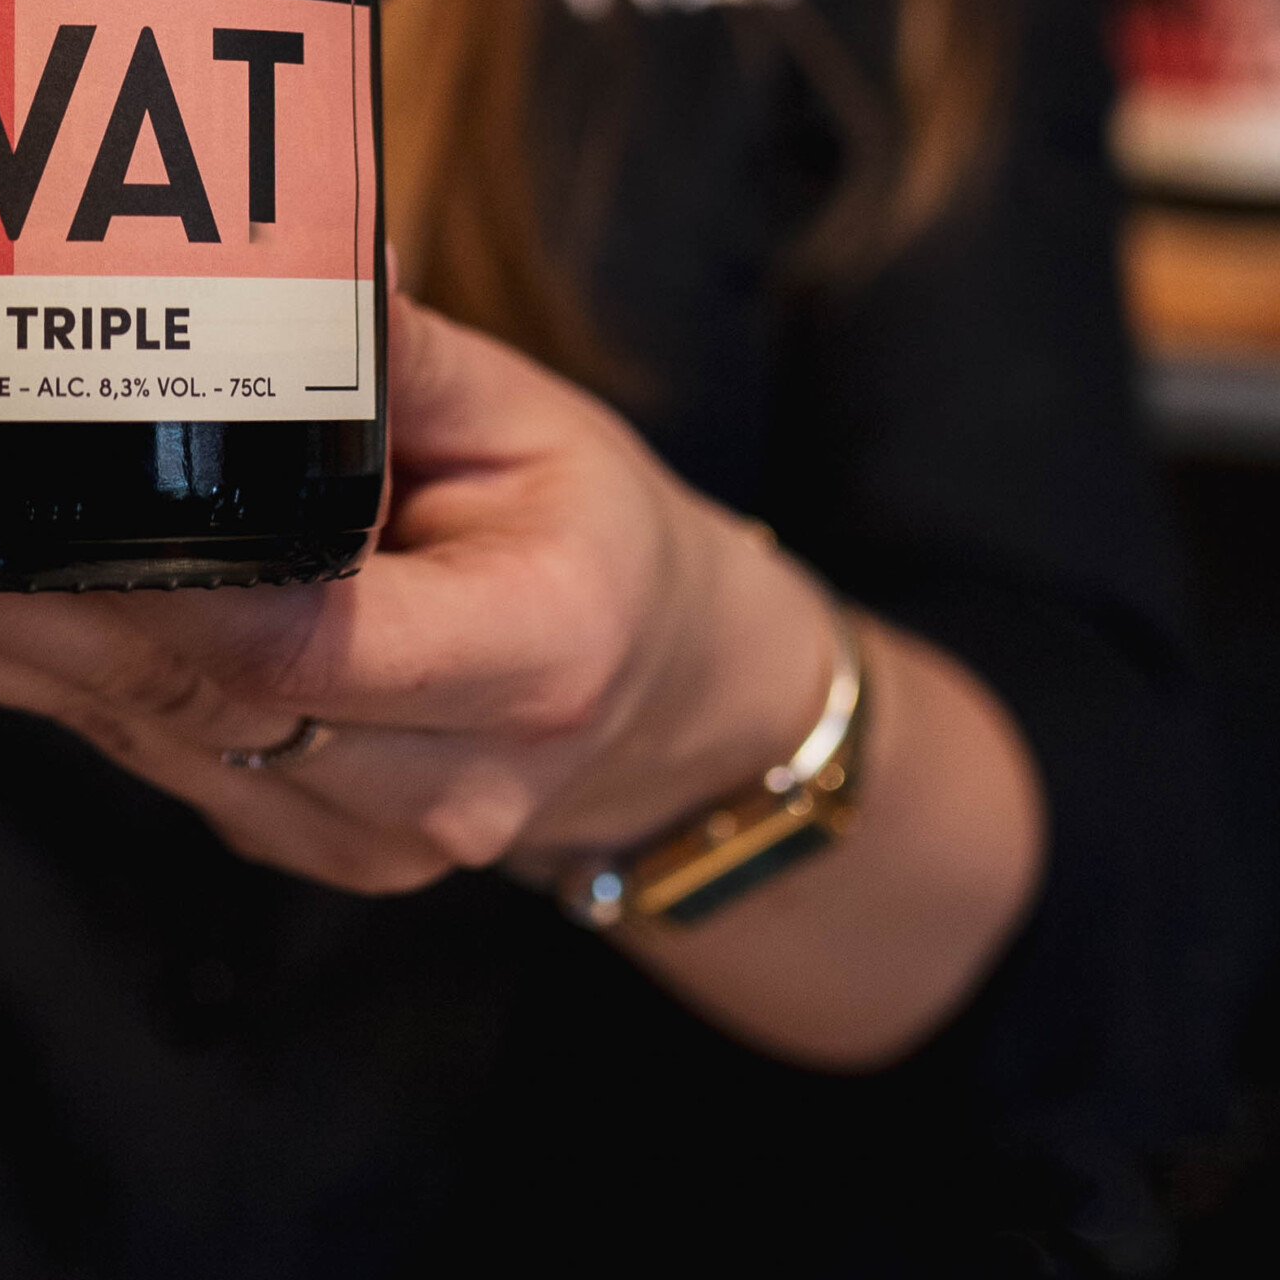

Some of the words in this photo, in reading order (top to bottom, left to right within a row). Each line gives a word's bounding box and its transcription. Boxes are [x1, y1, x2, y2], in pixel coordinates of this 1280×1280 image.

[5, 306, 192, 351] TRIPLE
[36, 375, 92, 399] ALC.
[98, 376, 152, 402] 8,3%
[156, 376, 208, 399] VOL.
[229, 376, 278, 399] 75CL
